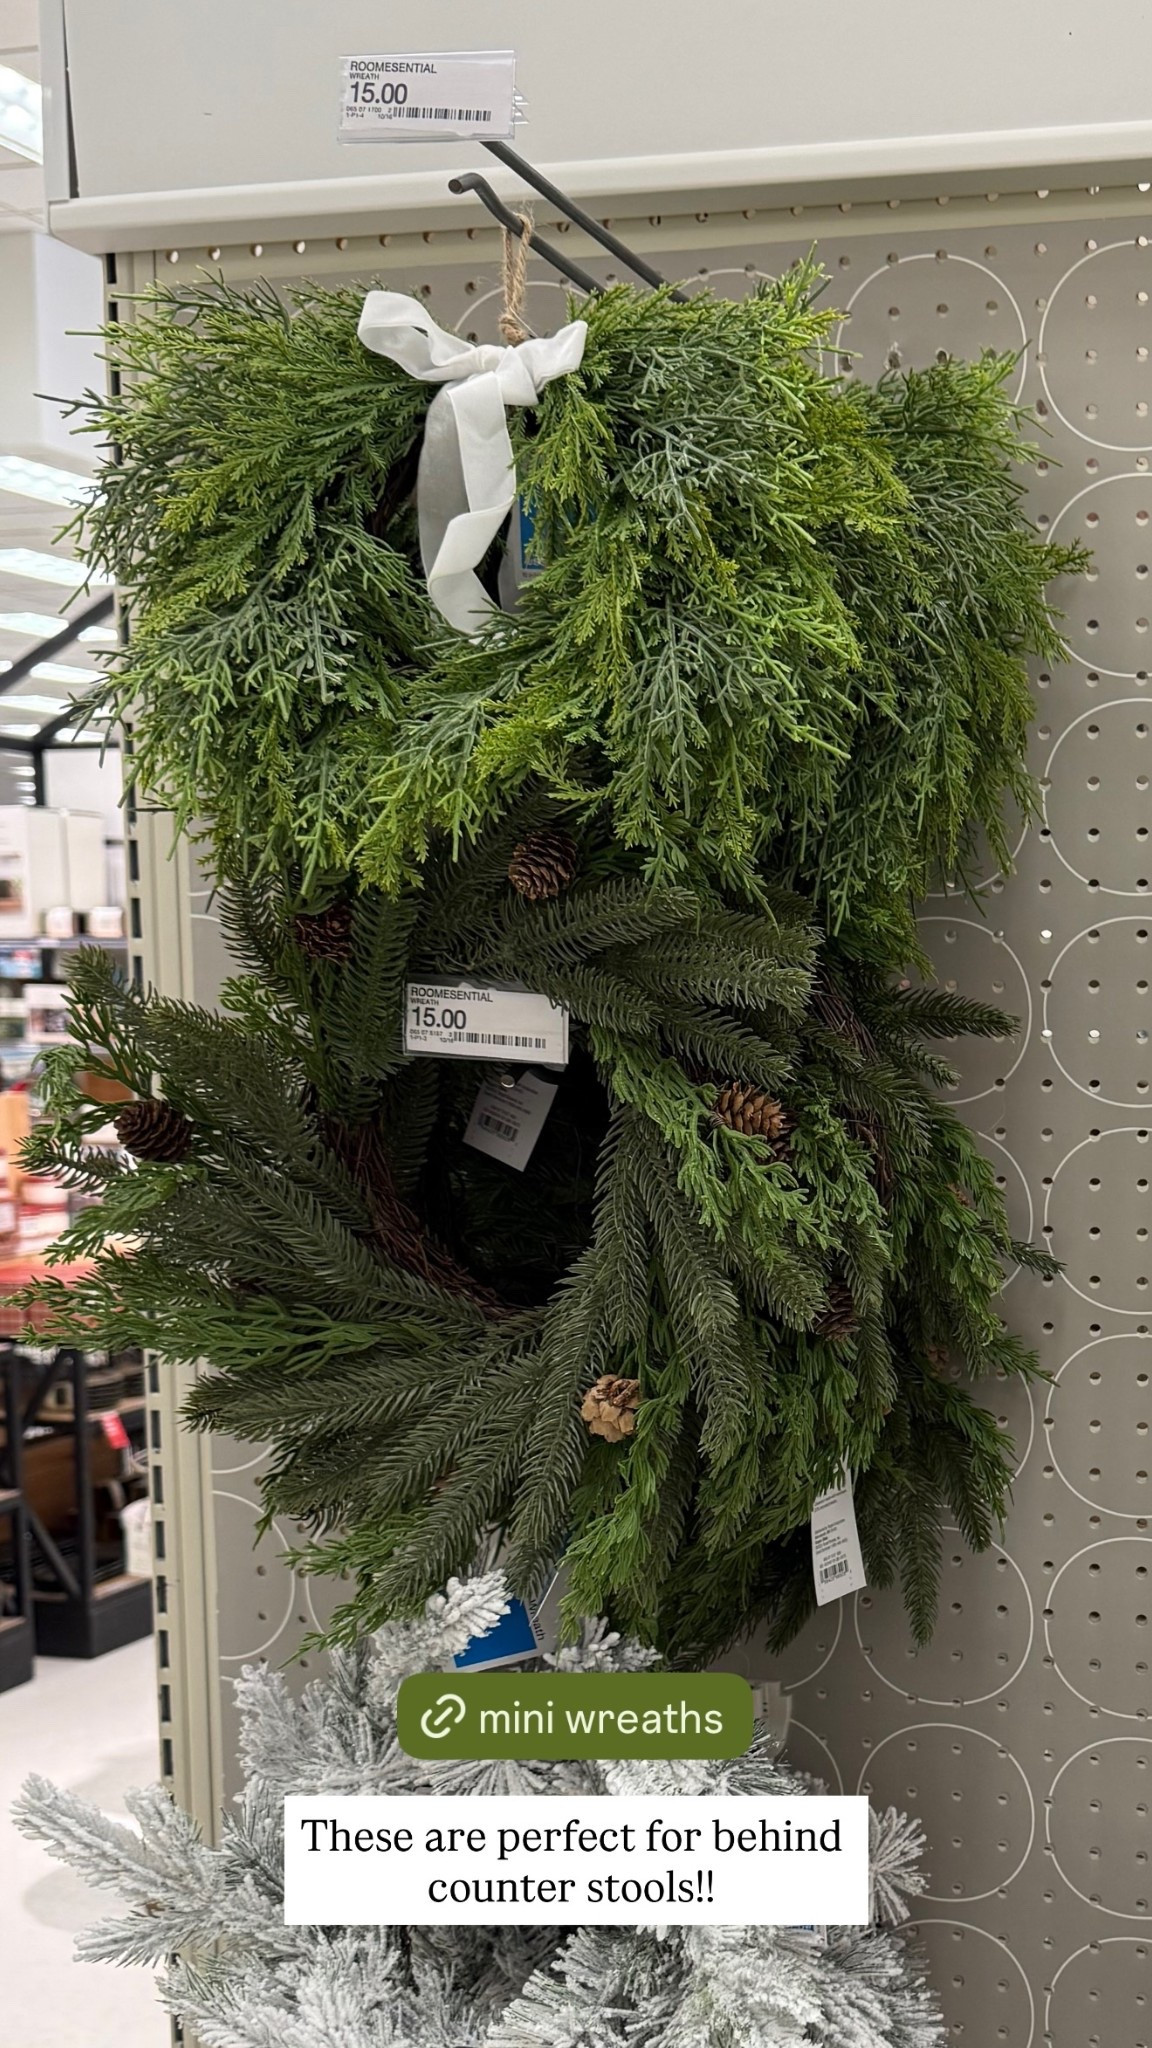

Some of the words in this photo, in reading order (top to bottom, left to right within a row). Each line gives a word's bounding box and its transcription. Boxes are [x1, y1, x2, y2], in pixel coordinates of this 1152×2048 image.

[350, 61, 437, 73] ROOMESENTIAL
[351, 81, 408, 104] 15.00
[411, 987, 493, 1002] ROOMESENTIAL
[411, 998, 440, 1006] WREATH
[412, 1006, 467, 1029] 15.00
